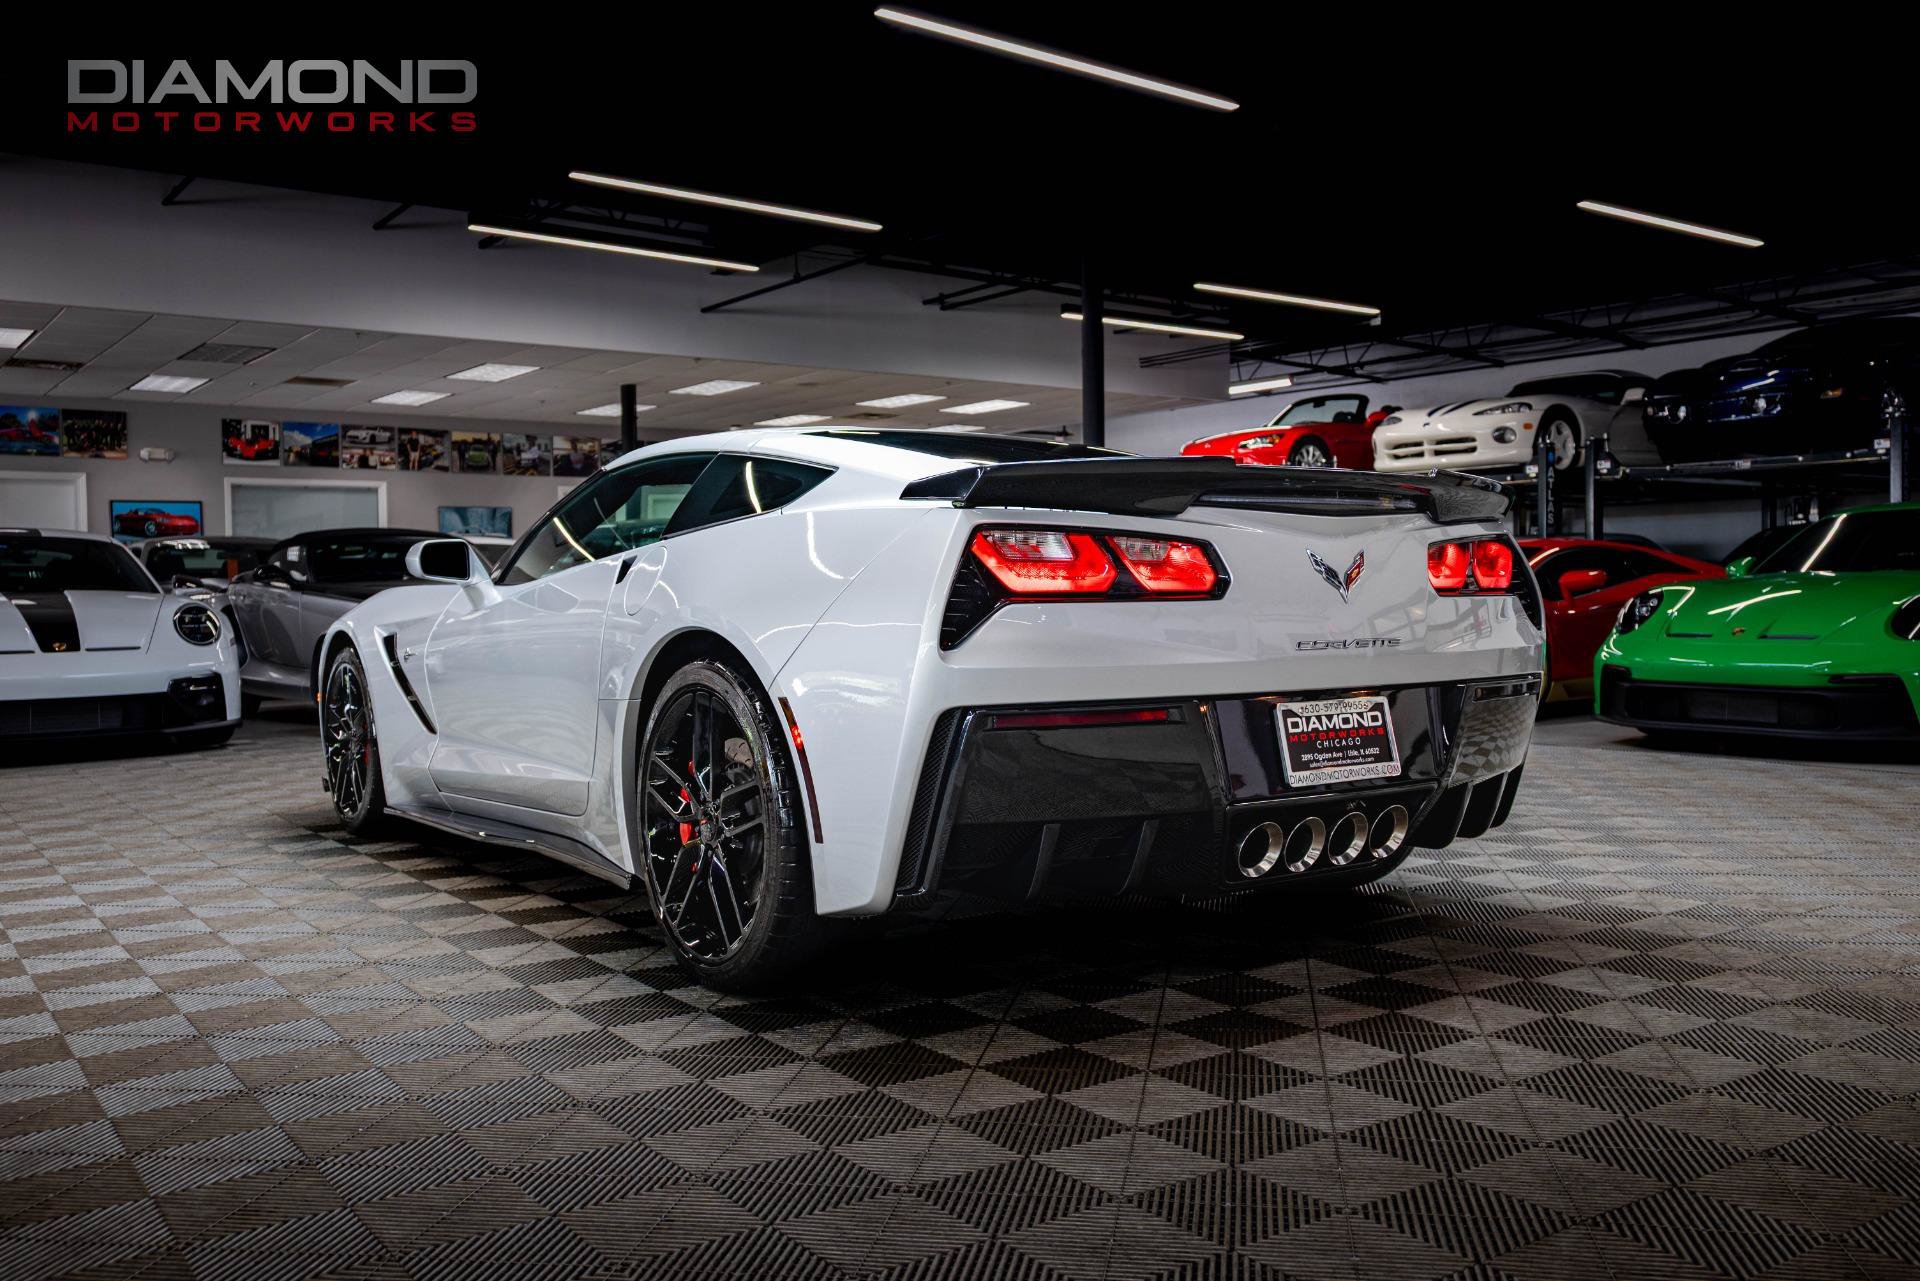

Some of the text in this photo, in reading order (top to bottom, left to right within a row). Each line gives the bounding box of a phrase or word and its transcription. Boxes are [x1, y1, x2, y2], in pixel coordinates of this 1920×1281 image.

[1296, 637, 1402, 651] CORVETTE
[1286, 711, 1383, 733] DIAMOND
[1288, 727, 1385, 743] MOTORWORKS
[1316, 737, 1361, 749] CHICAGO
